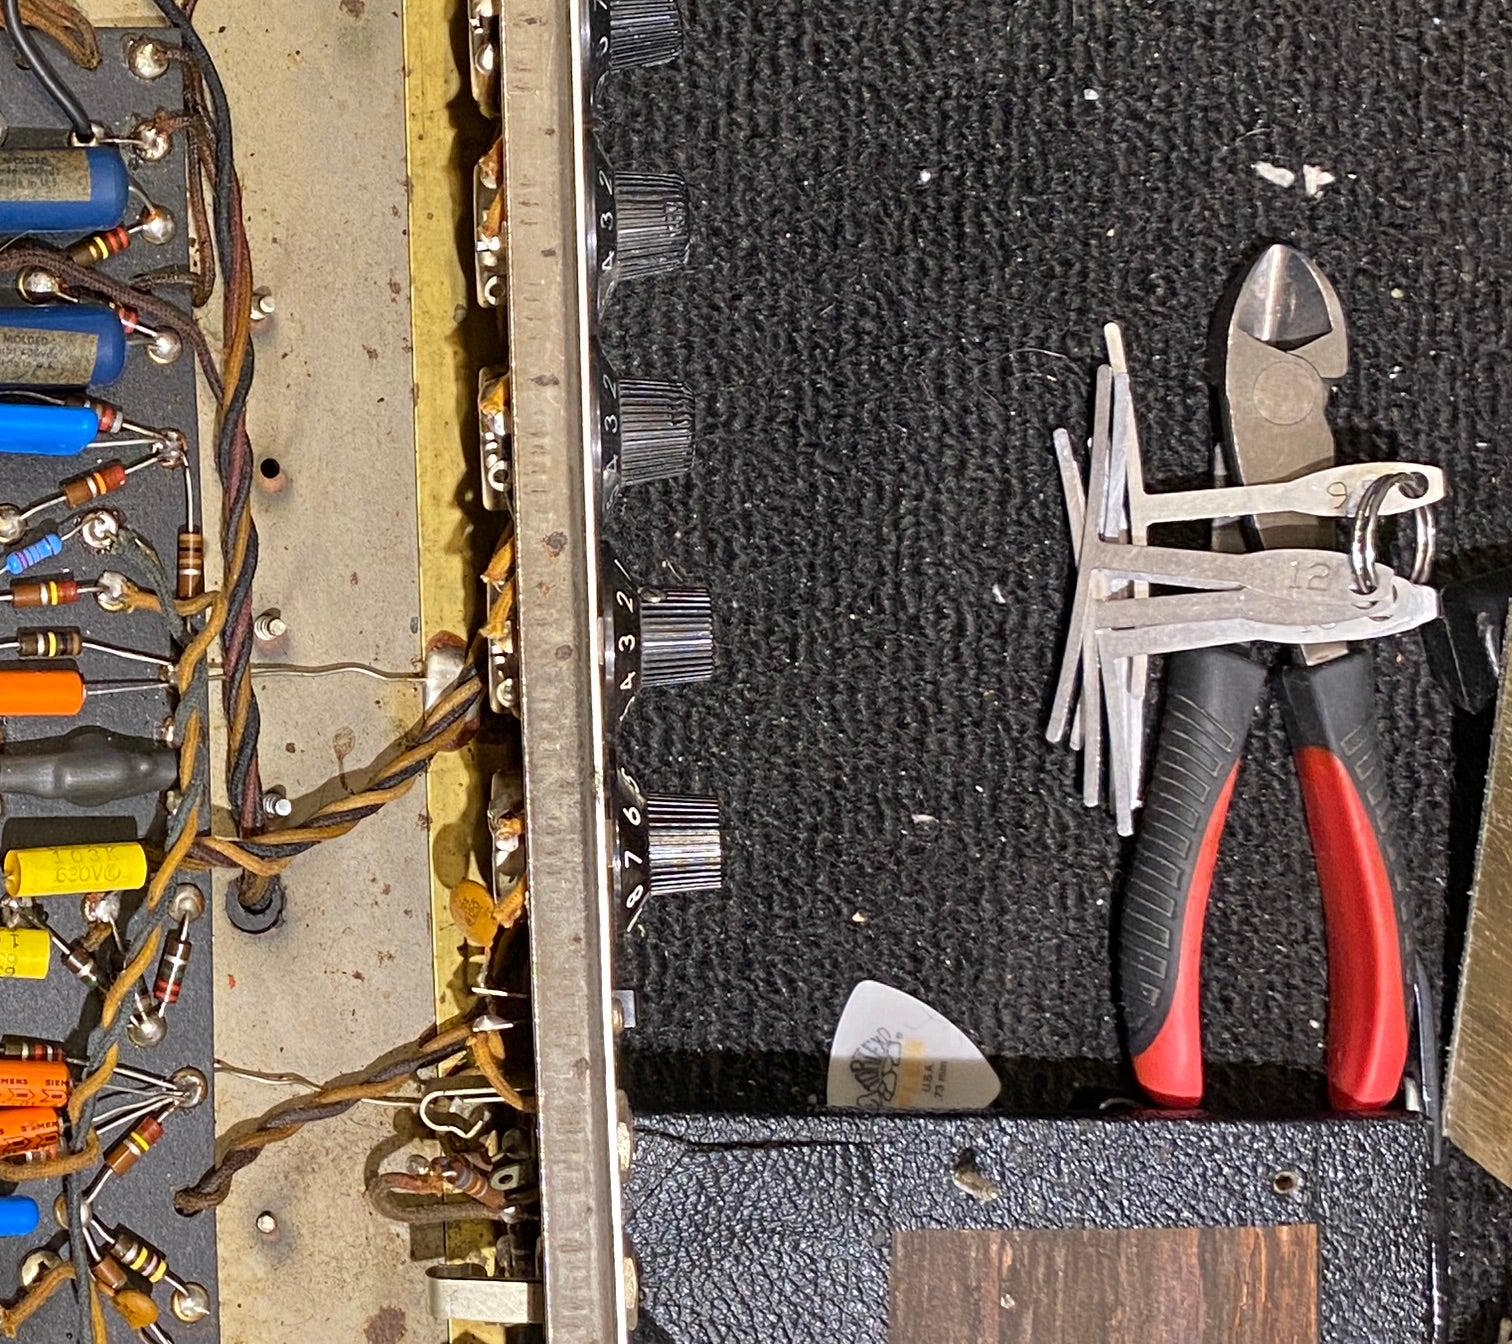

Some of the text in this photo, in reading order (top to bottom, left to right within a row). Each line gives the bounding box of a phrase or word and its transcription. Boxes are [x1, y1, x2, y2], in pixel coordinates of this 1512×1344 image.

[600, 169, 613, 196] 2
[600, 210, 614, 231] 3
[601, 250, 615, 271] 4
[603, 372, 618, 400] 2
[604, 413, 619, 434] 3
[605, 453, 619, 474] 4
[1288, 561, 1332, 592] 12
[616, 589, 635, 614] 2
[618, 633, 637, 654] 3
[620, 670, 636, 692] 4
[622, 806, 642, 827] 6
[623, 849, 643, 870] 7
[625, 883, 644, 909] 8
[937, 1060, 948, 1083] mm
